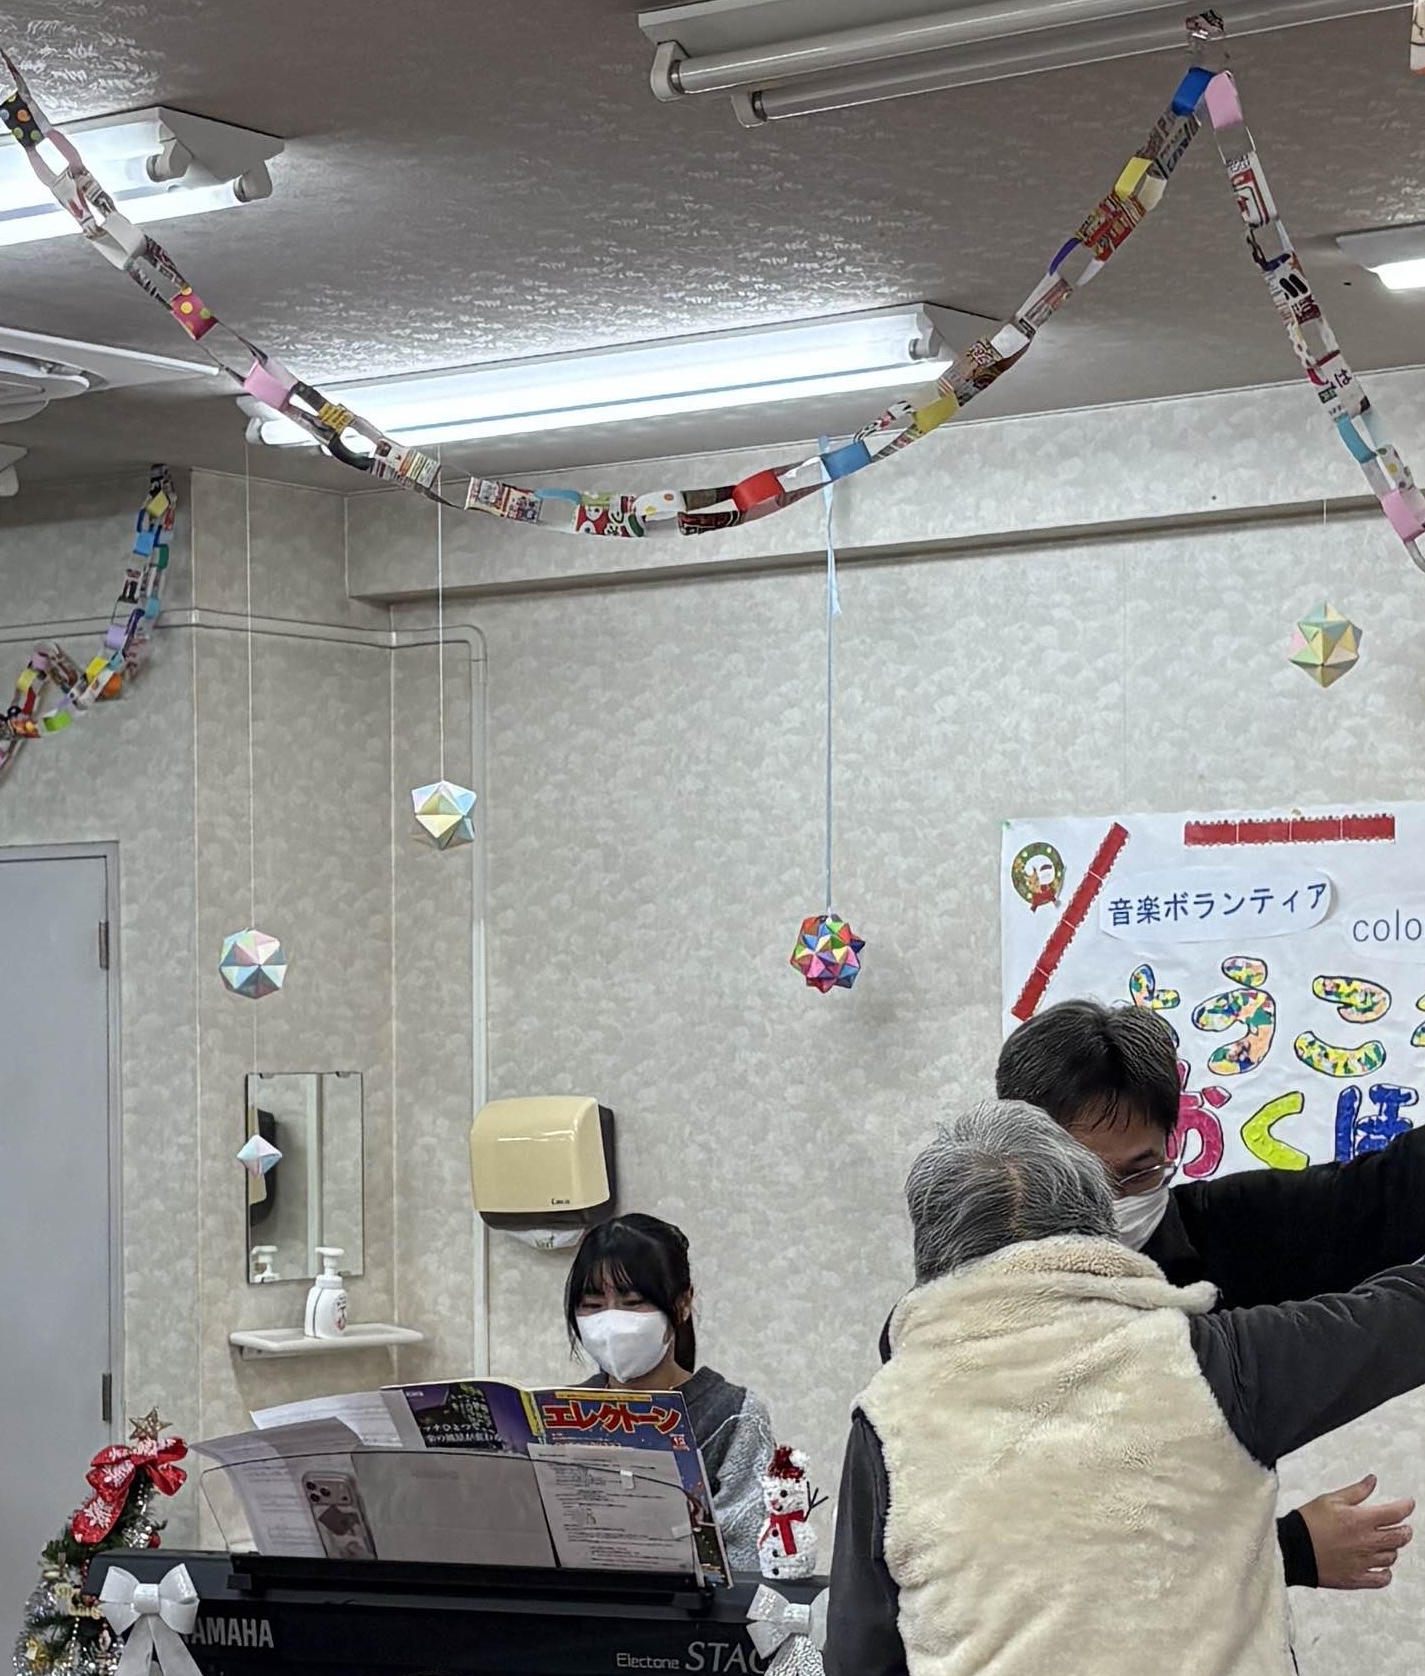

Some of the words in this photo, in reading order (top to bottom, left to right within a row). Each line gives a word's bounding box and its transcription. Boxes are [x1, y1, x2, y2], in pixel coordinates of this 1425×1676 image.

[1107, 882, 1328, 928] 音楽ボランティア
[542, 1400, 682, 1435] エレクトーン
[616, 1652, 680, 1671] Electone
